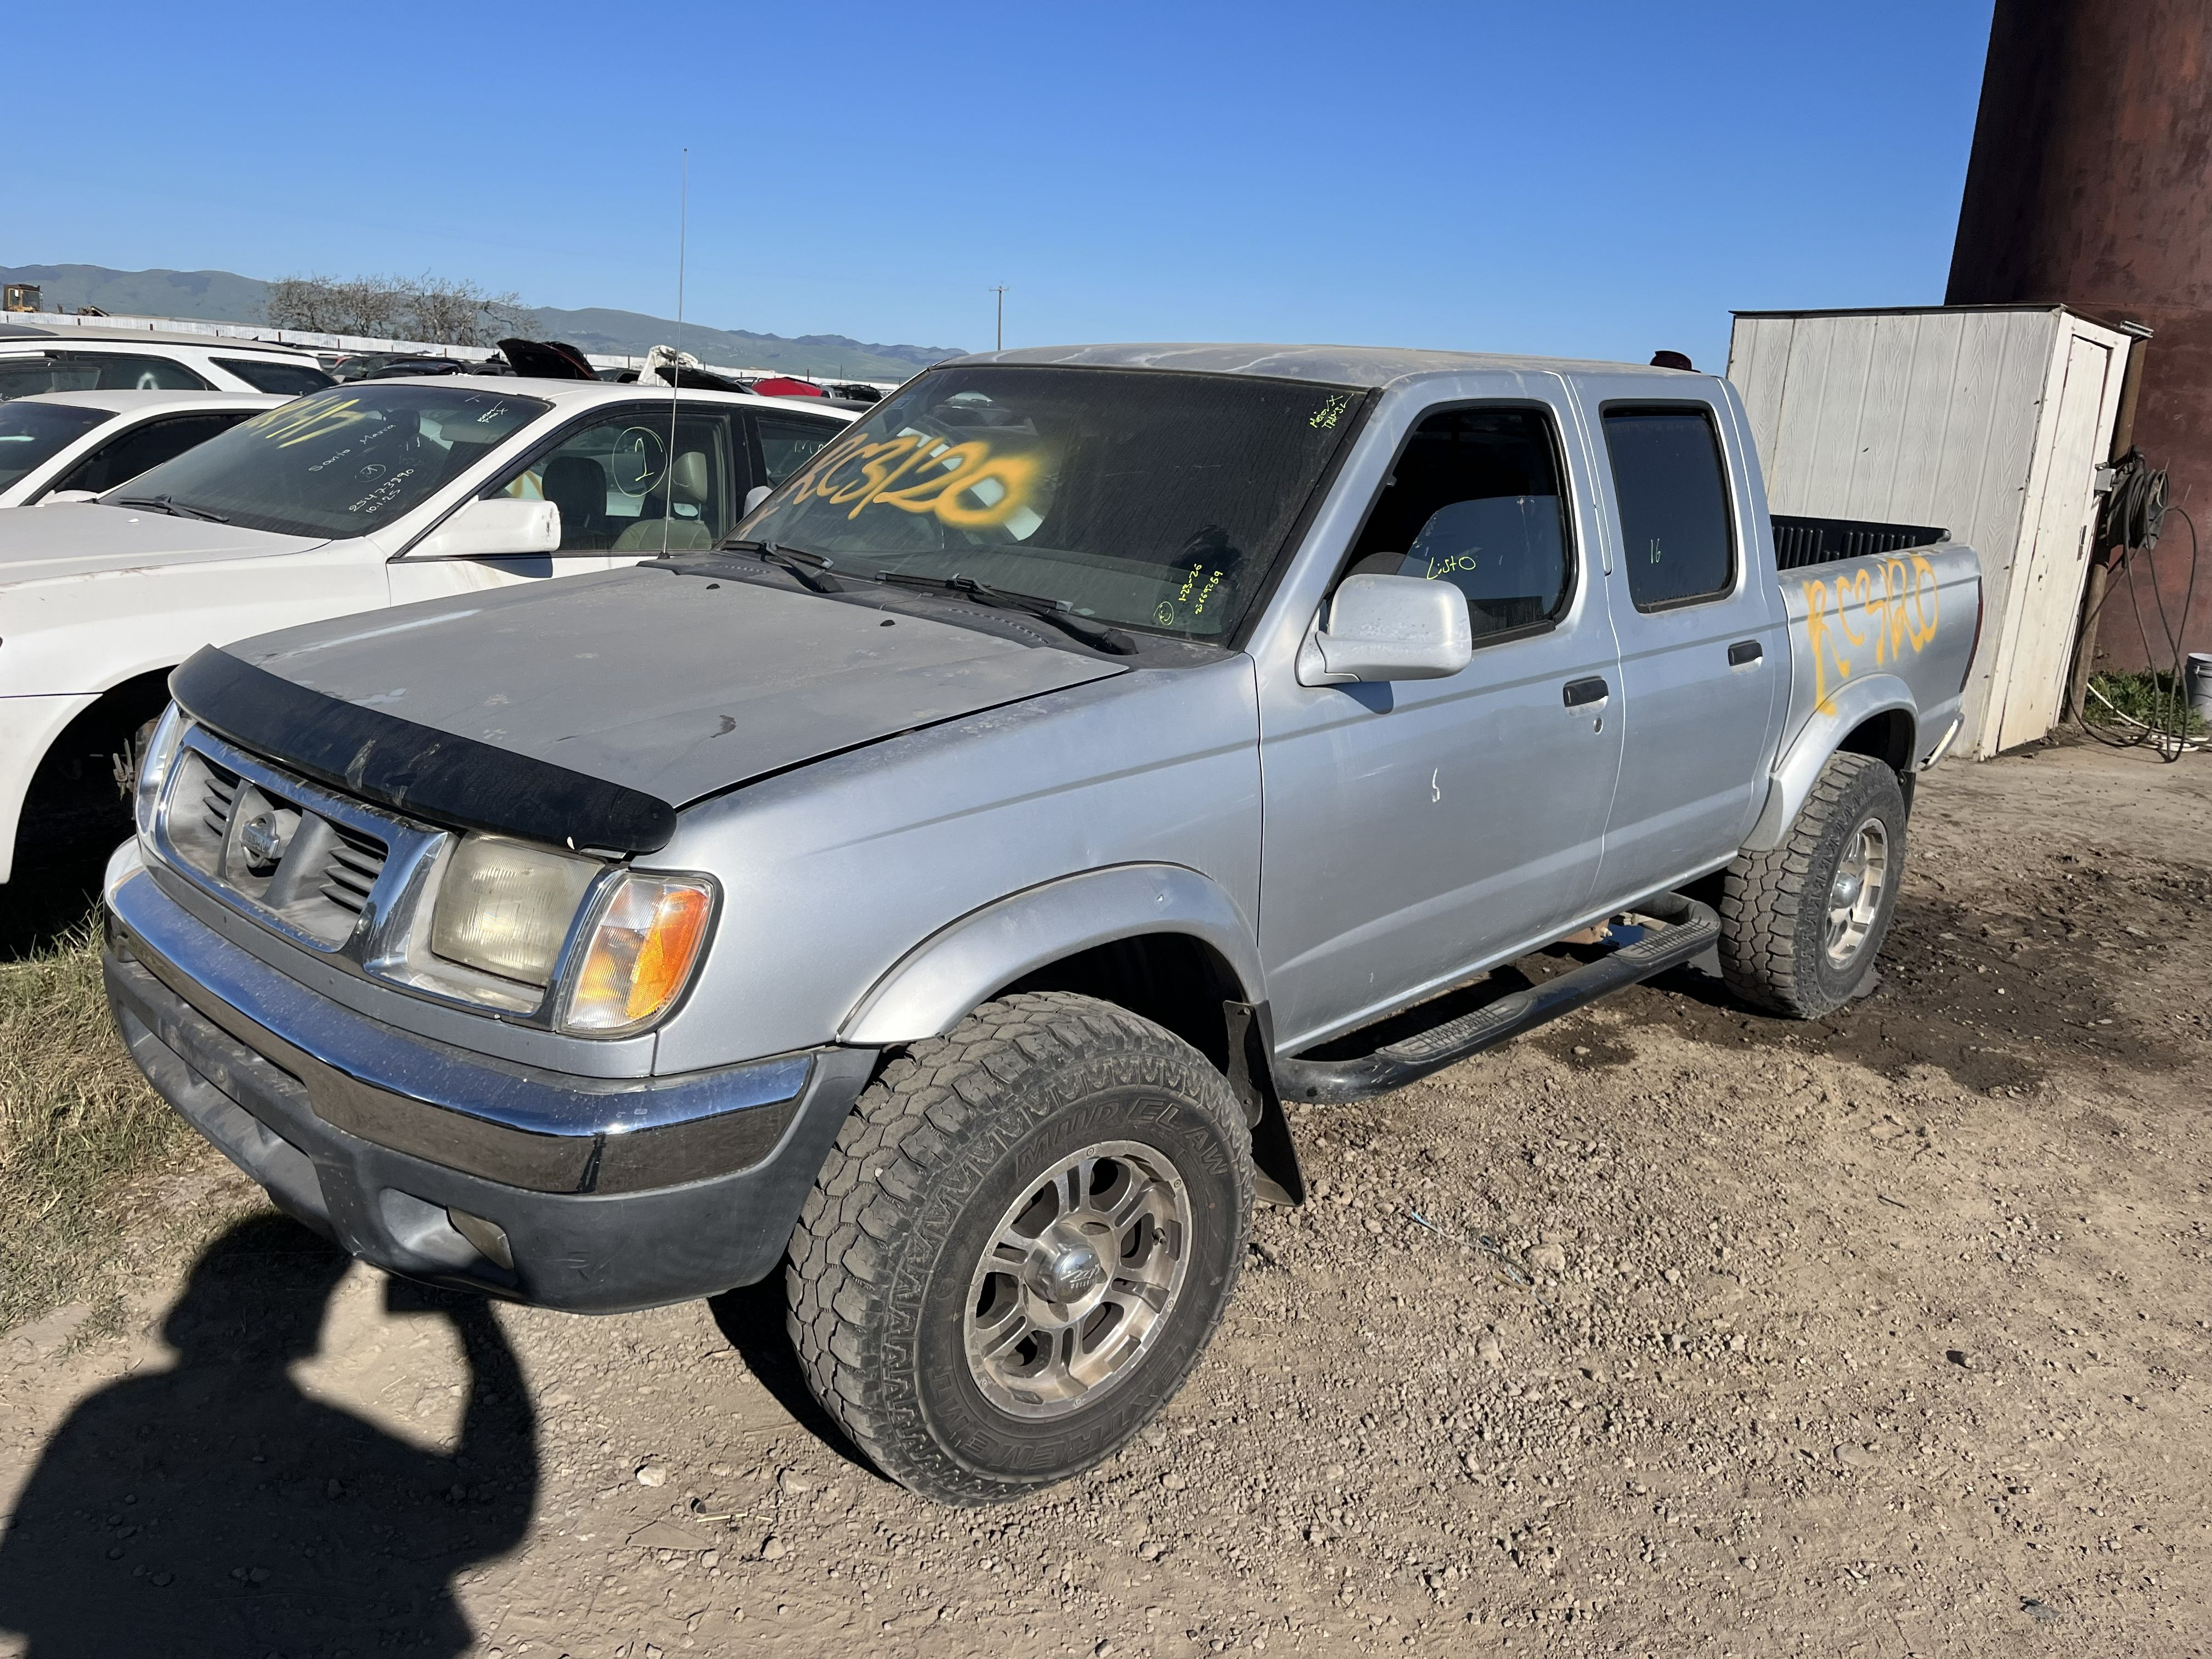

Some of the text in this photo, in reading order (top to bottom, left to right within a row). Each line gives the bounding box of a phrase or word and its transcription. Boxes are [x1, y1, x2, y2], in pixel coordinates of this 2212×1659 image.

[1178, 563, 1203, 601] 1-23-26
[1017, 1097, 1230, 1179] MUD CLAW
[962, 1345, 1187, 1472] EXTREME
